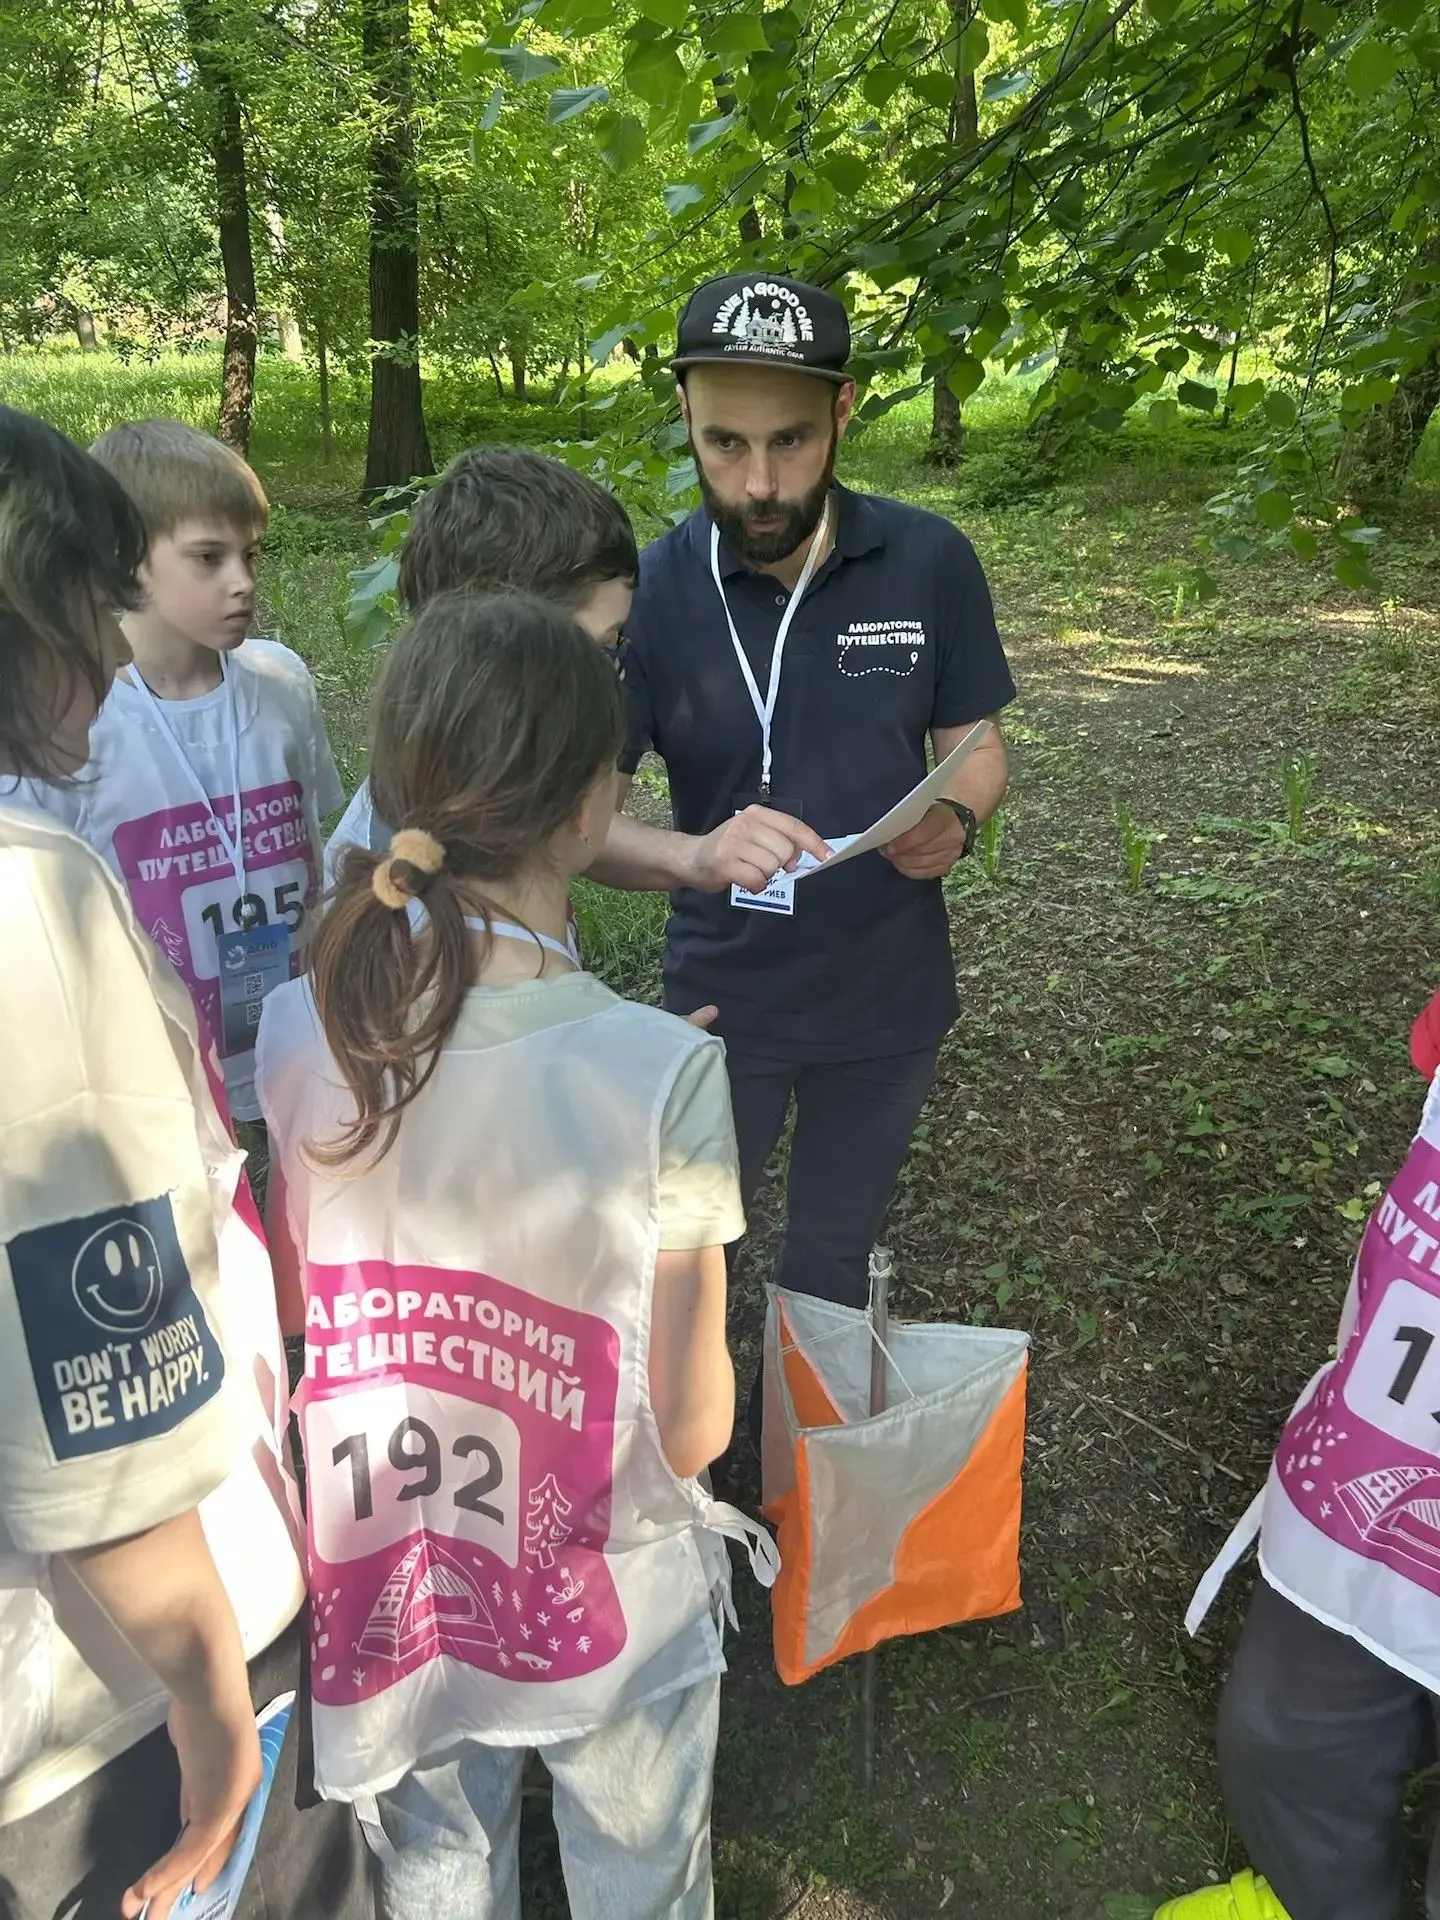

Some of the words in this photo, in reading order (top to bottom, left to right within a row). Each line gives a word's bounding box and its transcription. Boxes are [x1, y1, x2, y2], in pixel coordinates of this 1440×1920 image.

[711, 293, 743, 333] HAVE
[742, 286, 755, 302] A
[754, 282, 800, 307] GOOD
[795, 306, 814, 342] ONE
[748, 345, 786, 356] AUTHENTIC
[837, 630, 926, 646] ПУТЕШЕСТВИЙ
[848, 620, 922, 634] ЛАБОРАТОРИЯ
[53, 1343, 133, 1392] DON'T
[140, 1315, 200, 1366] WORRY
[1387, 1325, 1440, 1424] 1
[60, 1384, 115, 1434] BE
[119, 1346, 209, 1422] HAPPY.
[332, 1416, 504, 1526] 192
